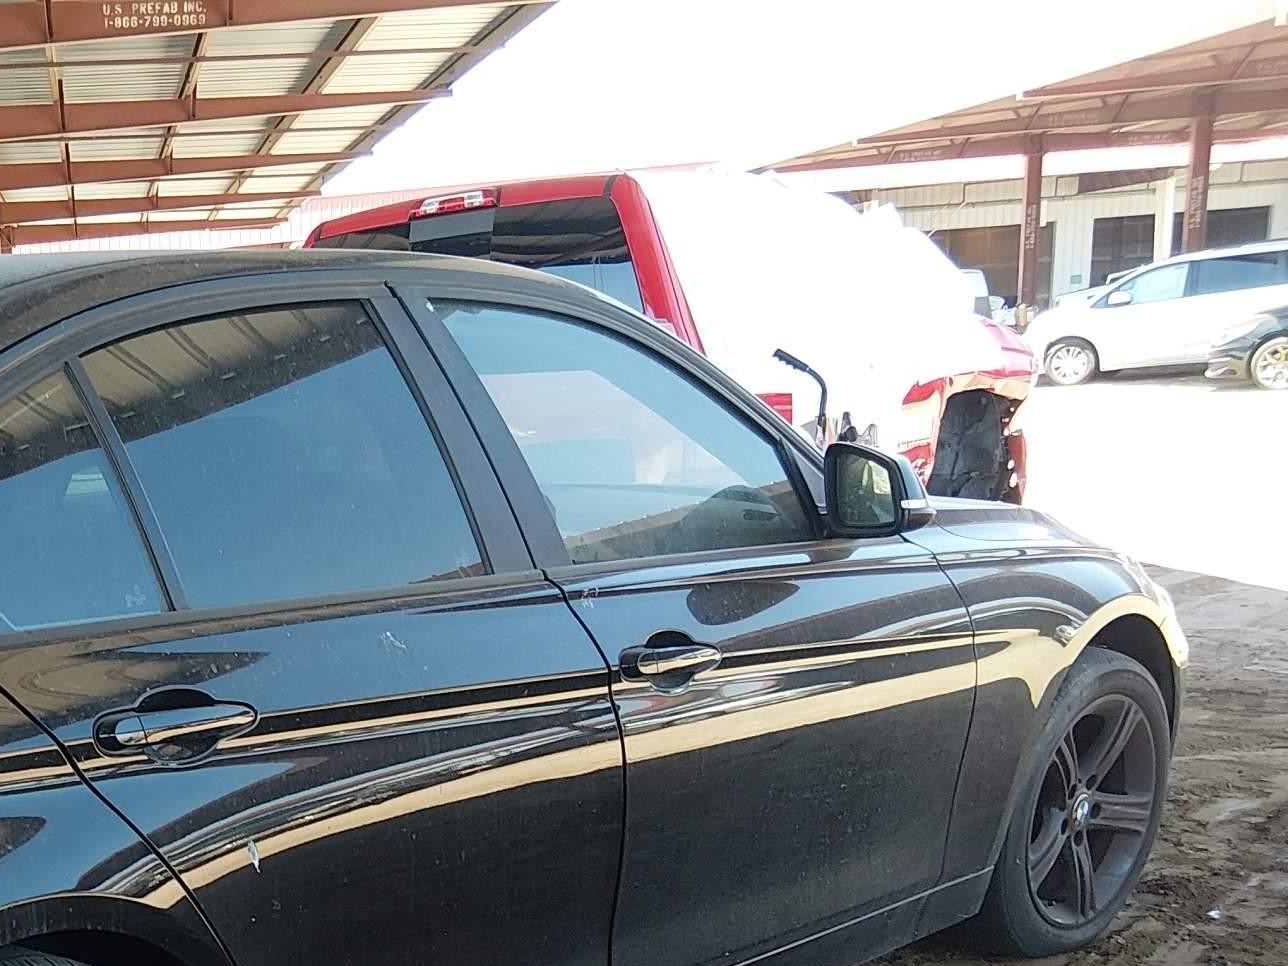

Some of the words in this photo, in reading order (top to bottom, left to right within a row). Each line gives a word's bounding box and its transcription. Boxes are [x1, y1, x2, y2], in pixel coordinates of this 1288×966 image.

[132, 2, 178, 14] PREFAB
[183, 1, 207, 13] INC.
[104, 14, 206, 28] 1-866-799-0969
